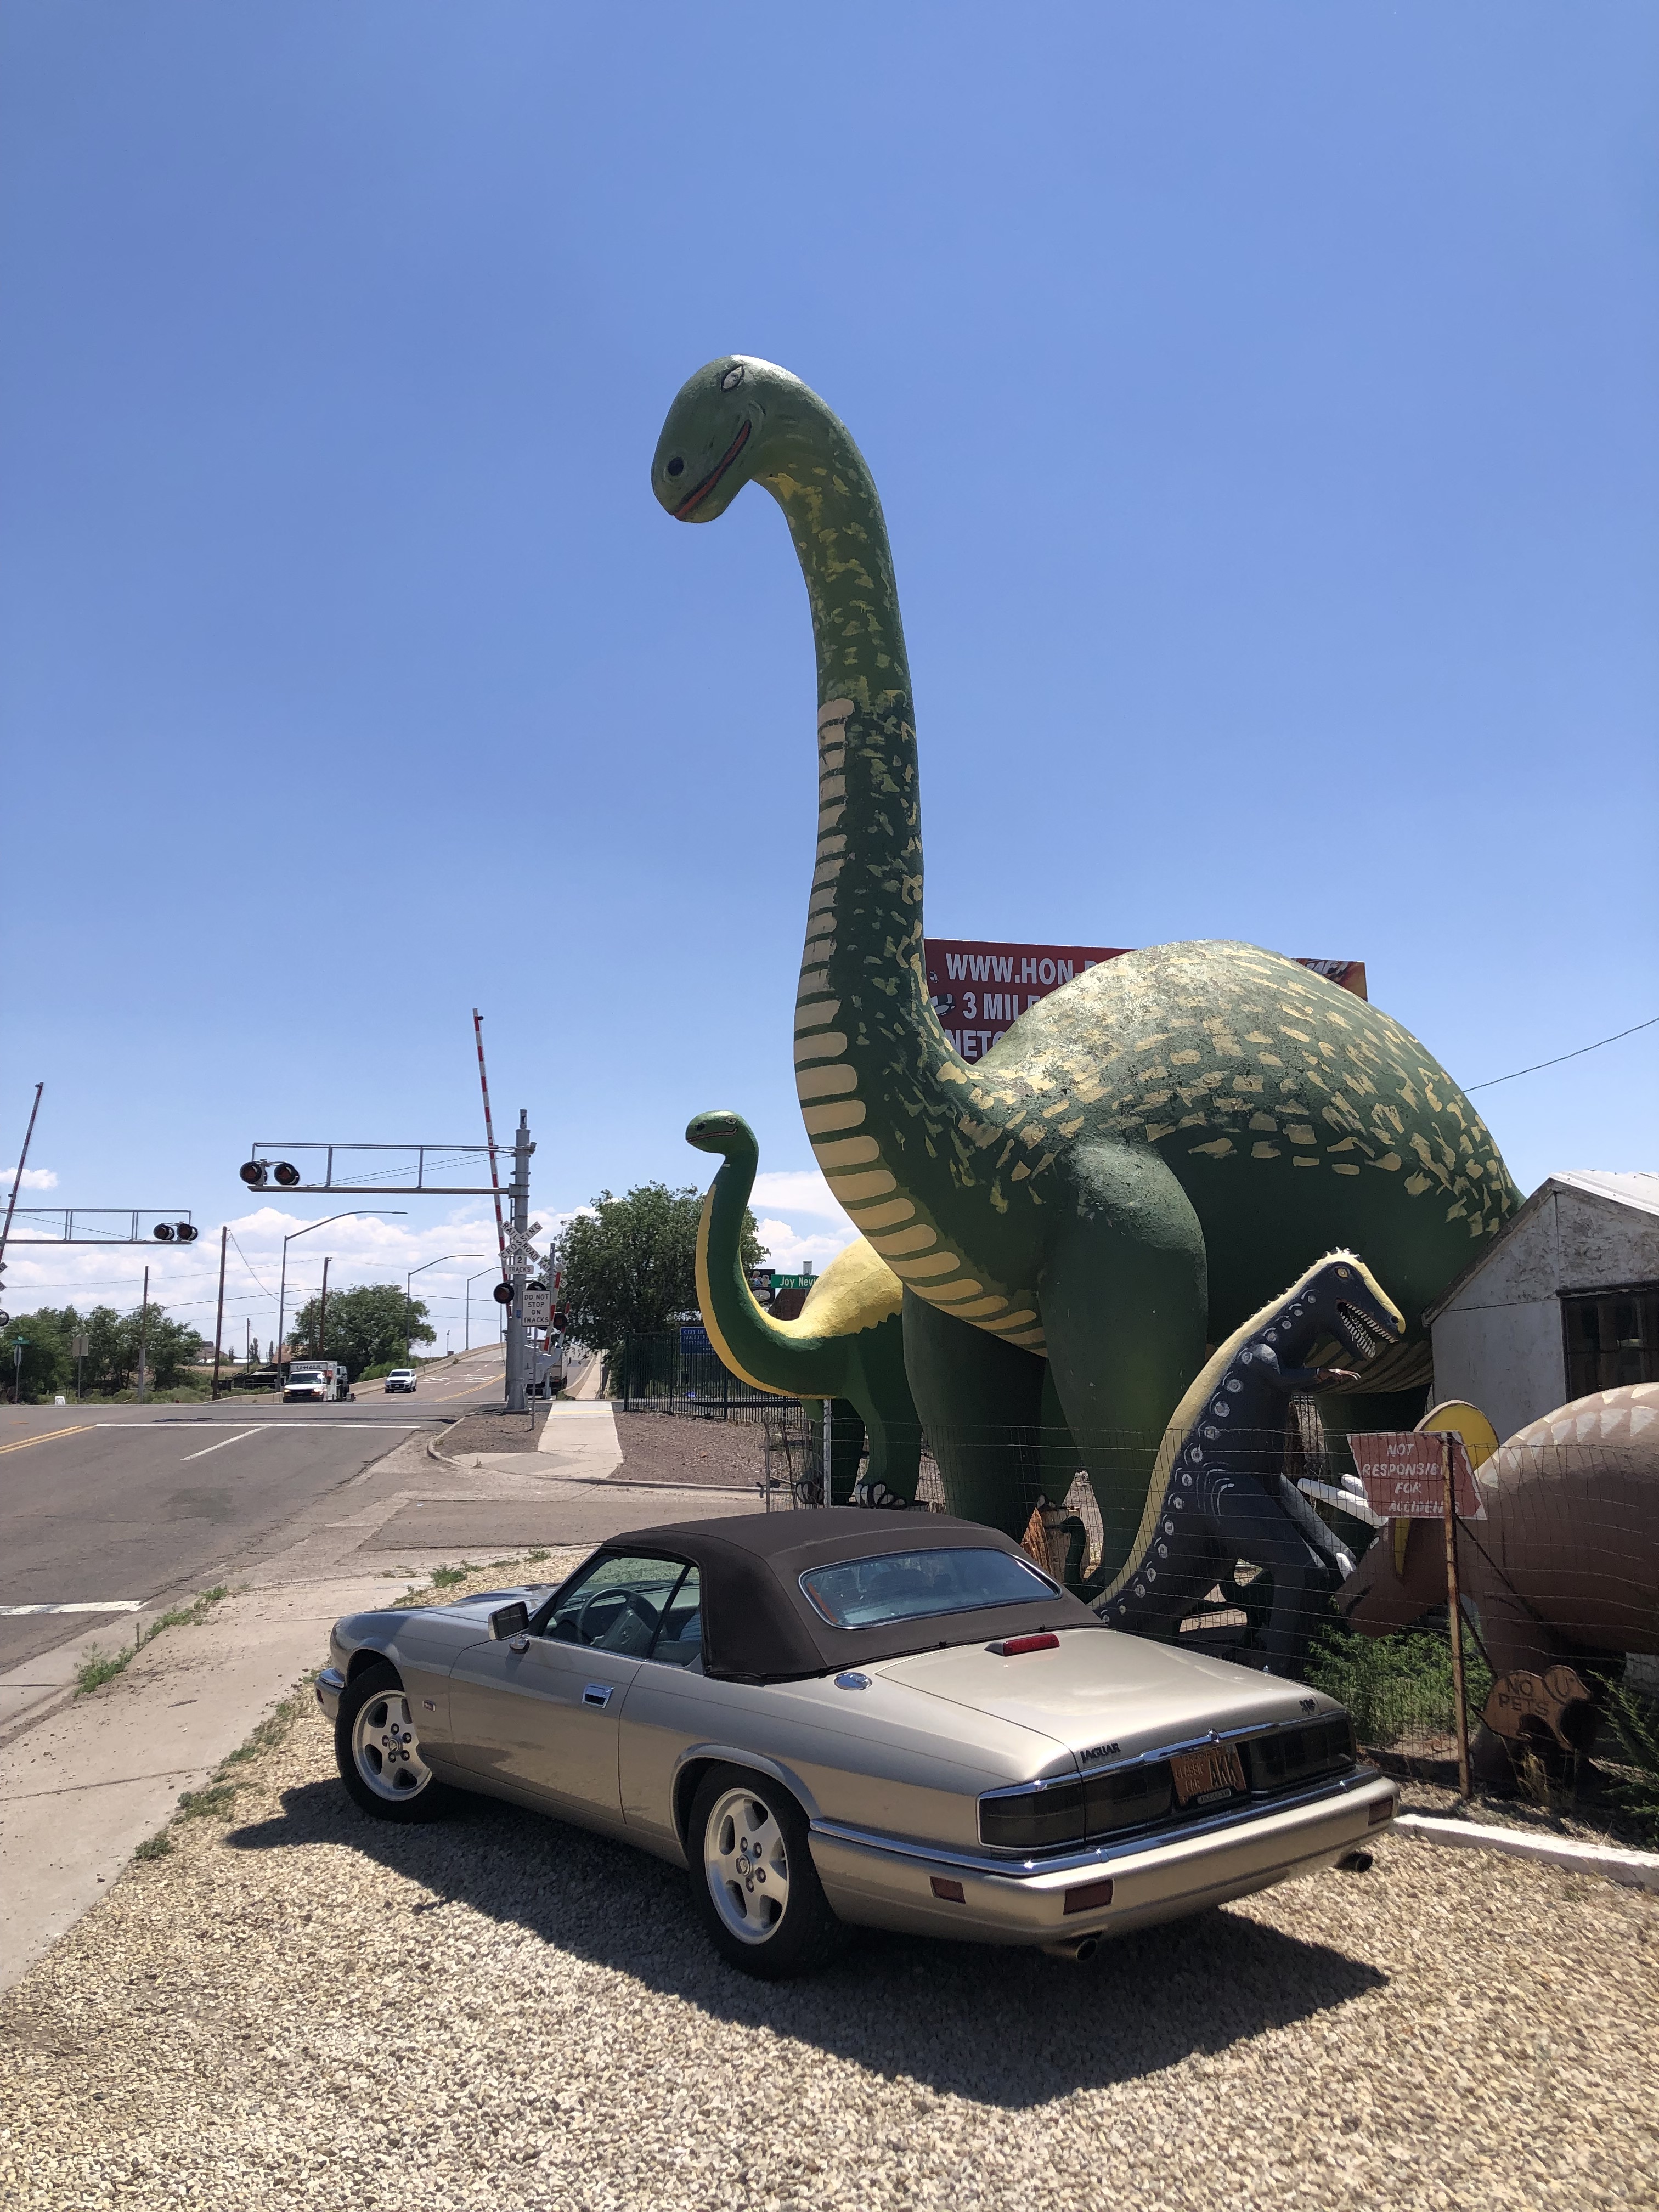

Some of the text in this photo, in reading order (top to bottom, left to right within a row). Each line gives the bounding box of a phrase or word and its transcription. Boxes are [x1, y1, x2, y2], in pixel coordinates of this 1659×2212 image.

[962, 991, 977, 1019] 3
[501, 1222, 541, 1259] CROSSING
[779, 1276, 795, 1288] Joy
[1386, 1443, 1415, 1457] NOT
[1395, 1482, 1422, 1494] FOR
[1388, 1500, 1460, 1514] ACCIDENS
[1505, 1677, 1534, 1697] NO
[1498, 1693, 1549, 1716] PETS
[1080, 1743, 1121, 1763] JAGUAR
[1175, 1763, 1204, 1779] CLASSIC
[1185, 1778, 1201, 1792] CAR
